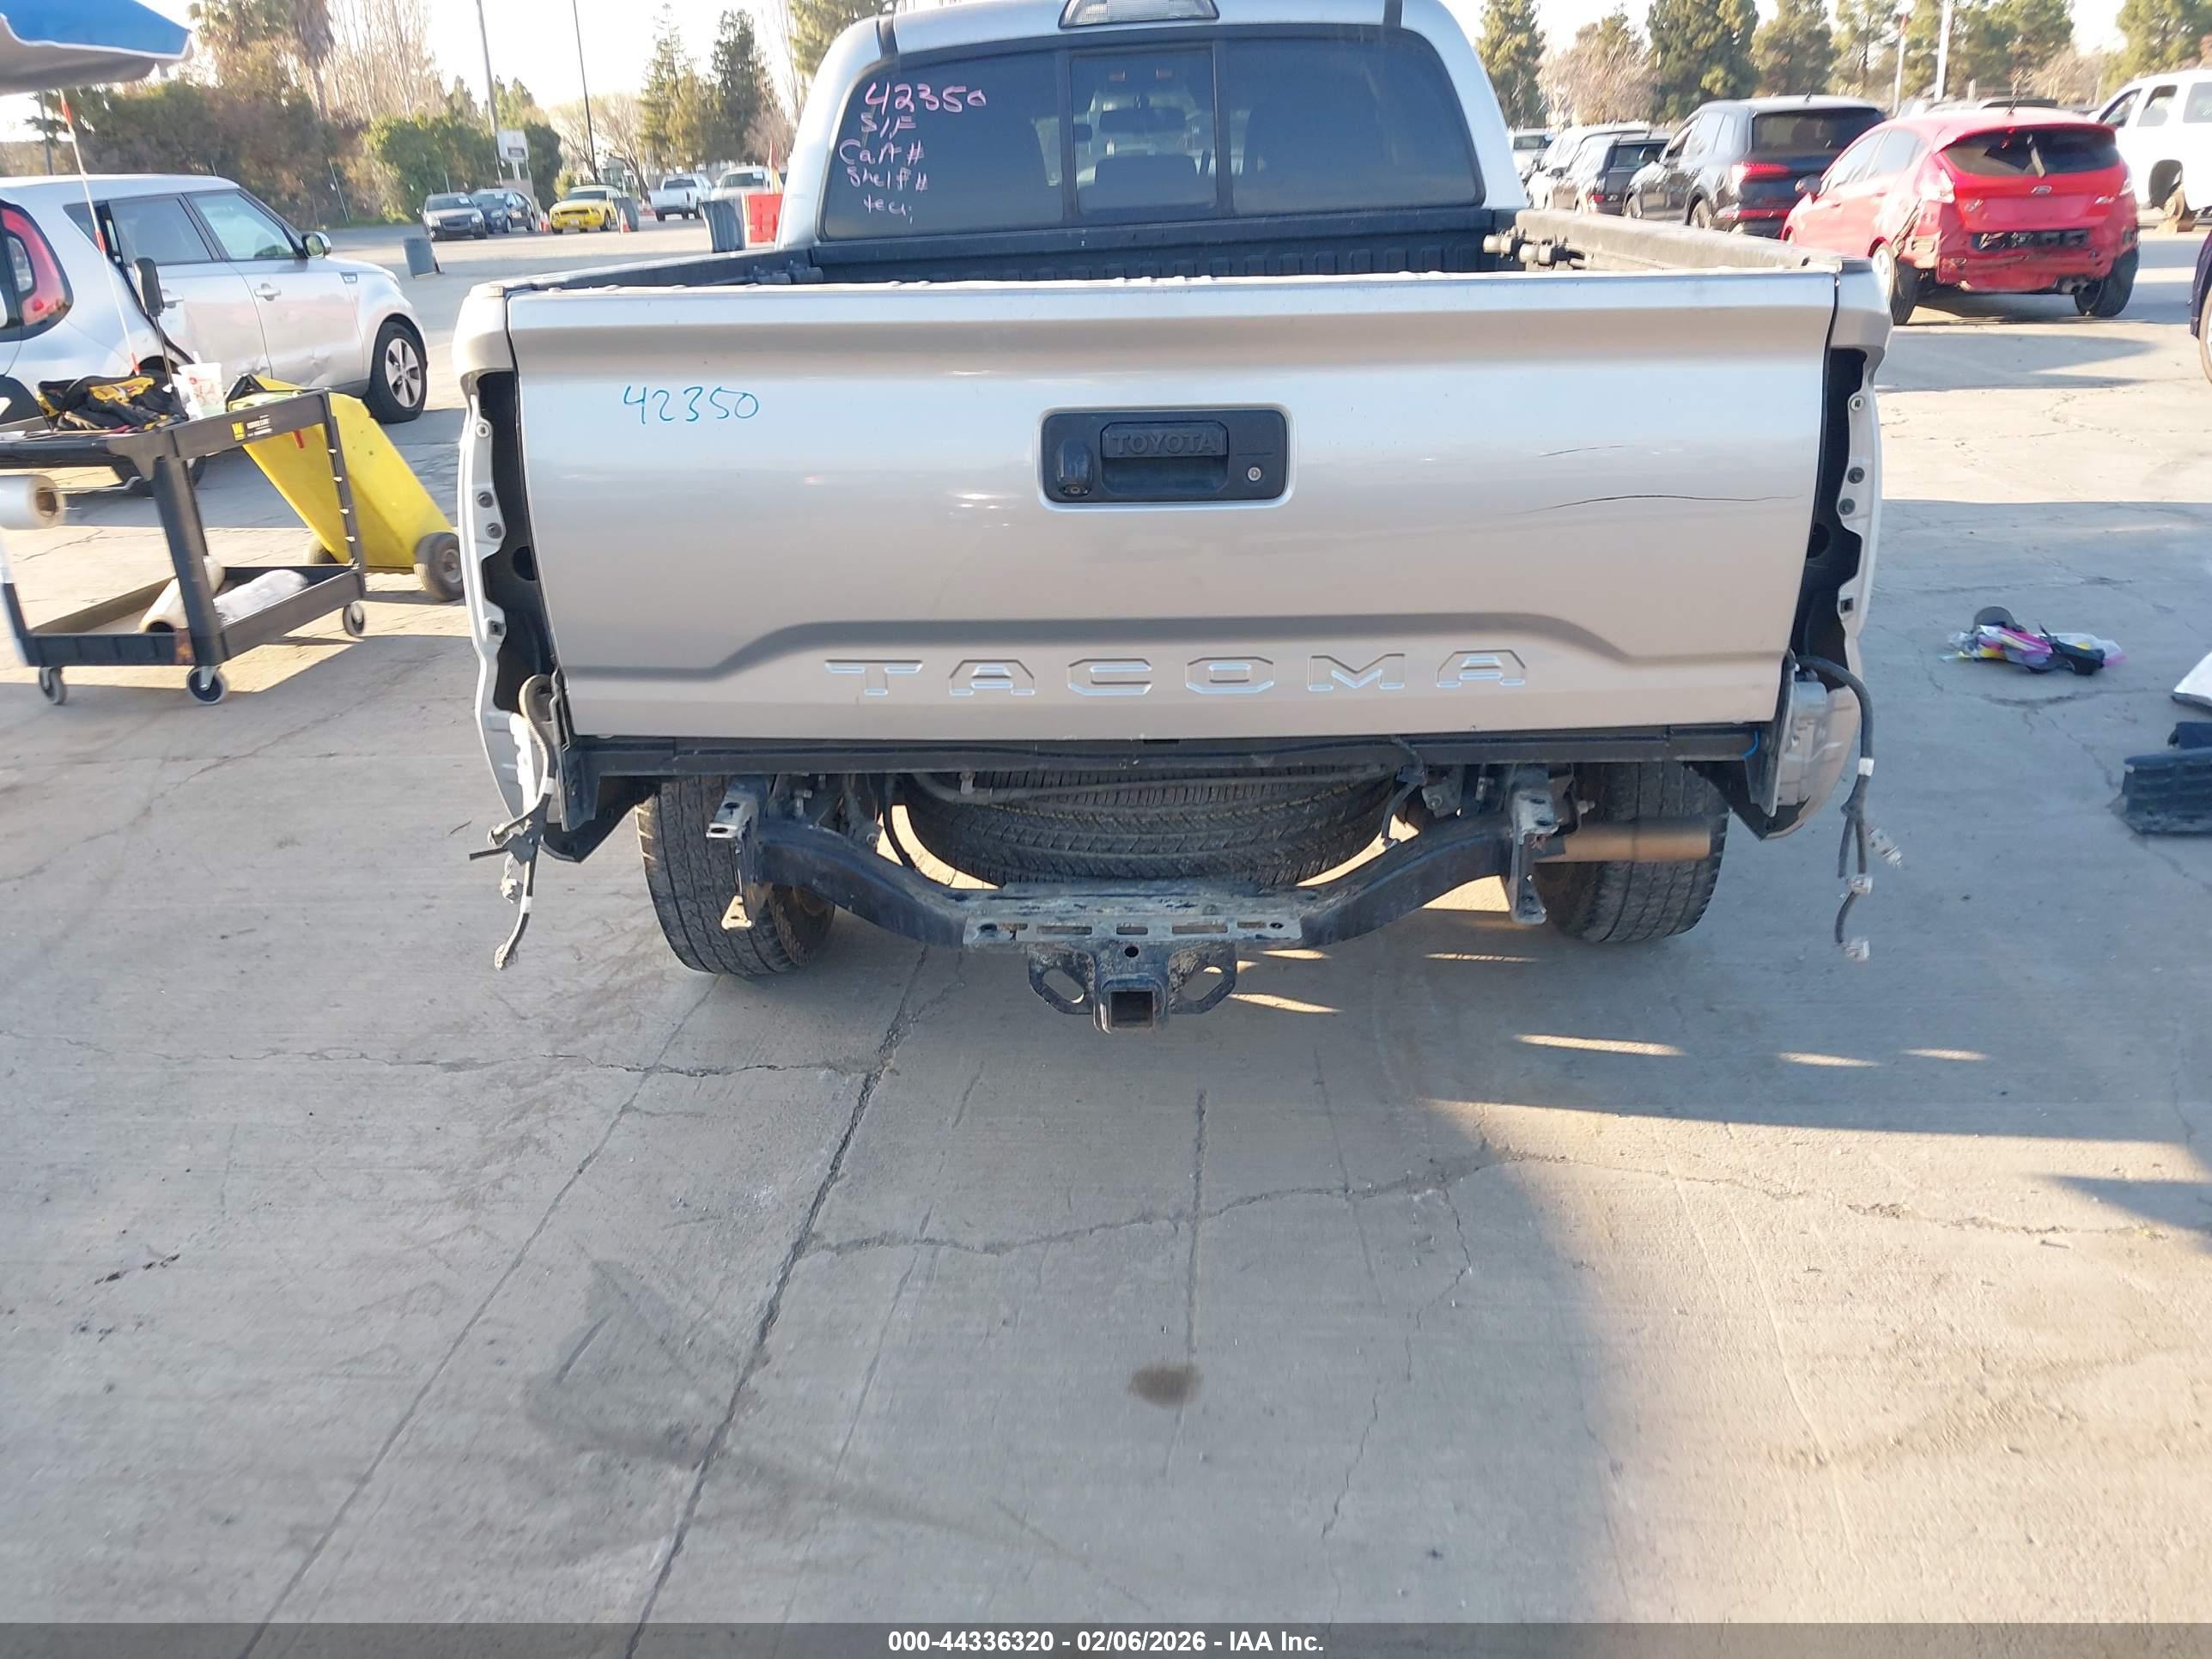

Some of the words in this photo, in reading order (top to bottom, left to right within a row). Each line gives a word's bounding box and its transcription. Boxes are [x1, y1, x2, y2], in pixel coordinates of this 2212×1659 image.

[865, 82, 987, 115] 42350
[906, 139, 925, 166] #
[623, 386, 759, 425] 42350
[1112, 434, 1218, 455] TOYOTA
[824, 649, 1527, 696] TACOMA
